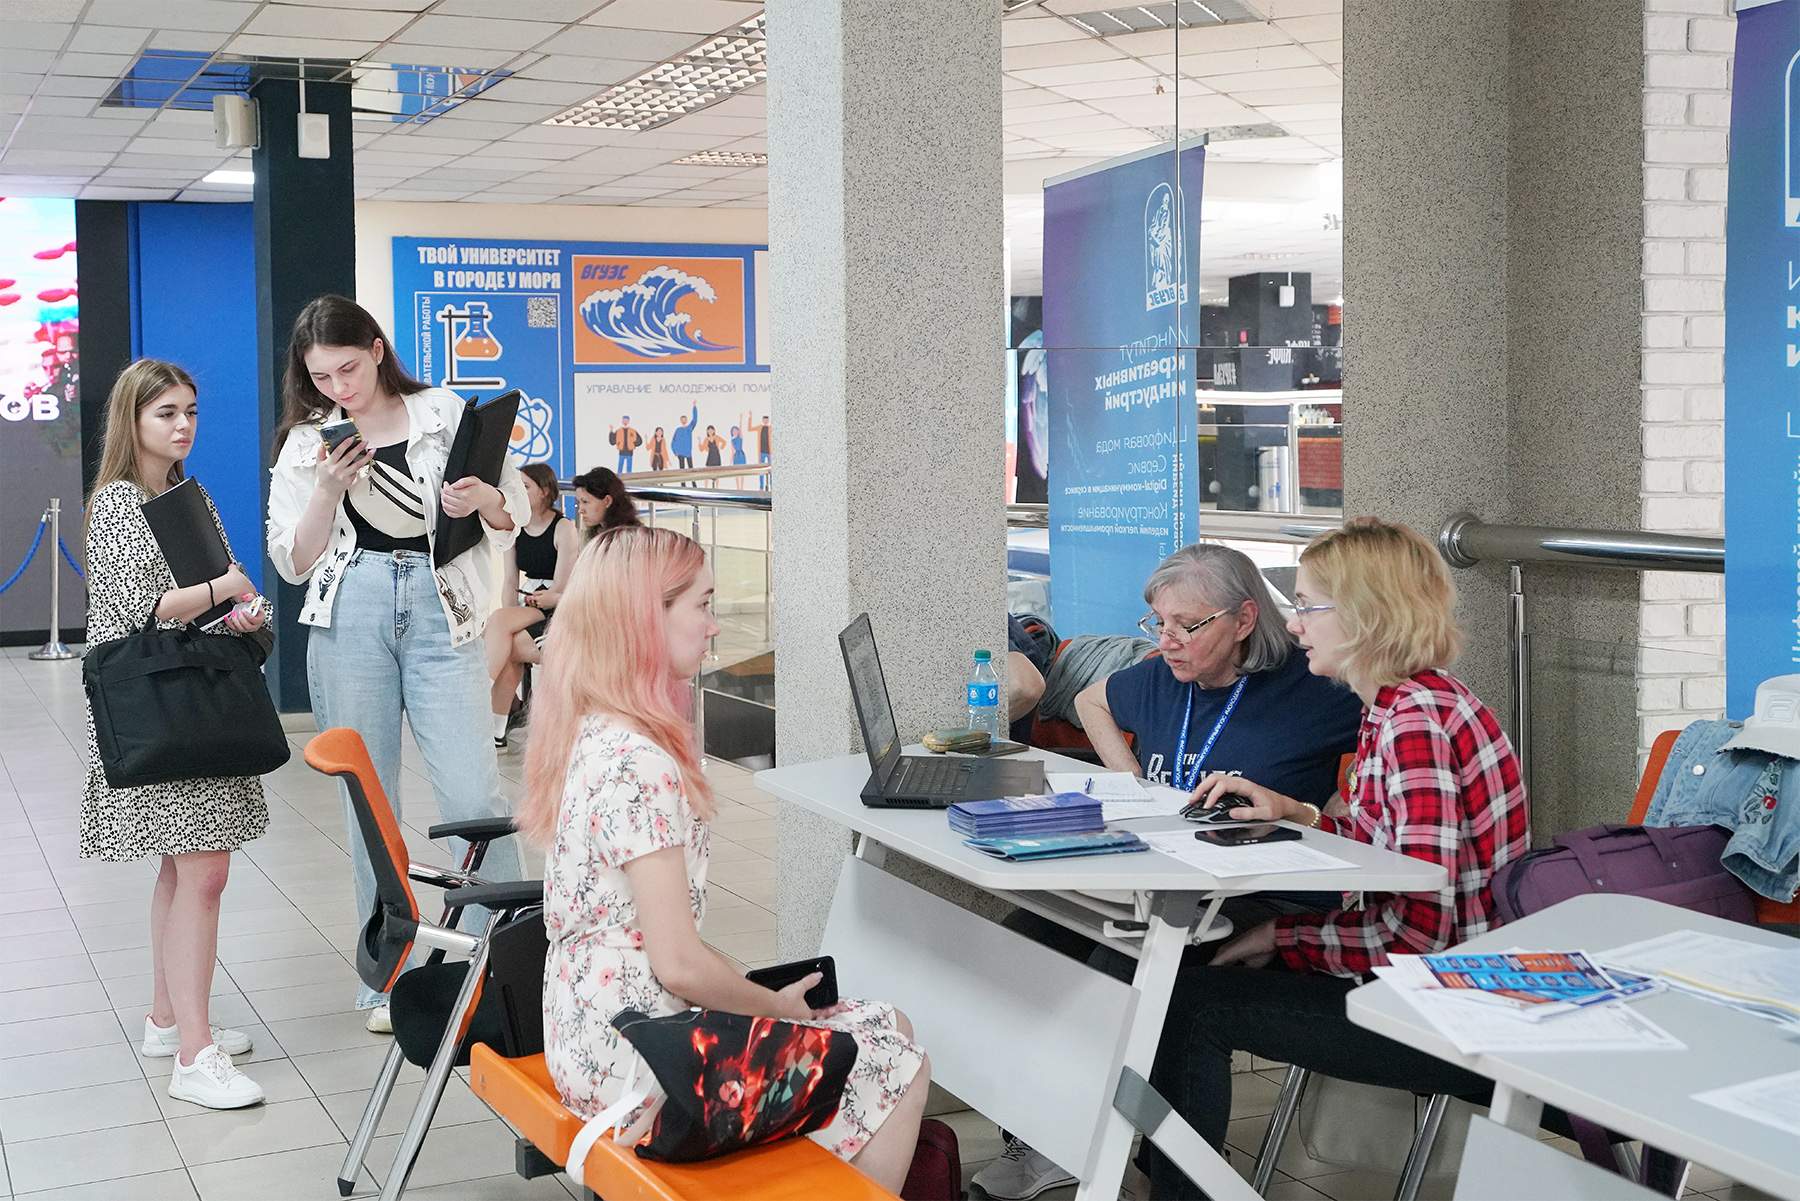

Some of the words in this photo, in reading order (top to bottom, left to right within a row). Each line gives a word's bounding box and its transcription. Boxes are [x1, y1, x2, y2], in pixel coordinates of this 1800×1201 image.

[417, 244, 458, 265] ТВОЙ
[460, 247, 561, 267] УНИВЕРСИТЕТ
[433, 270, 445, 289] В
[447, 270, 506, 291] ГОРОДЕ
[507, 271, 517, 289] У
[519, 272, 562, 290] МОРЯ
[580, 264, 629, 281] ВГУЭС
[422, 296, 431, 330] РАБОТЫ
[421, 332, 433, 386] ВАТЕЛЬСКОЙ
[586, 383, 652, 395] УПРАВЛЕНИЕ
[659, 382, 737, 396] МОЛОДЕЖНОЙ
[743, 383, 771, 395] ПОЛИ
